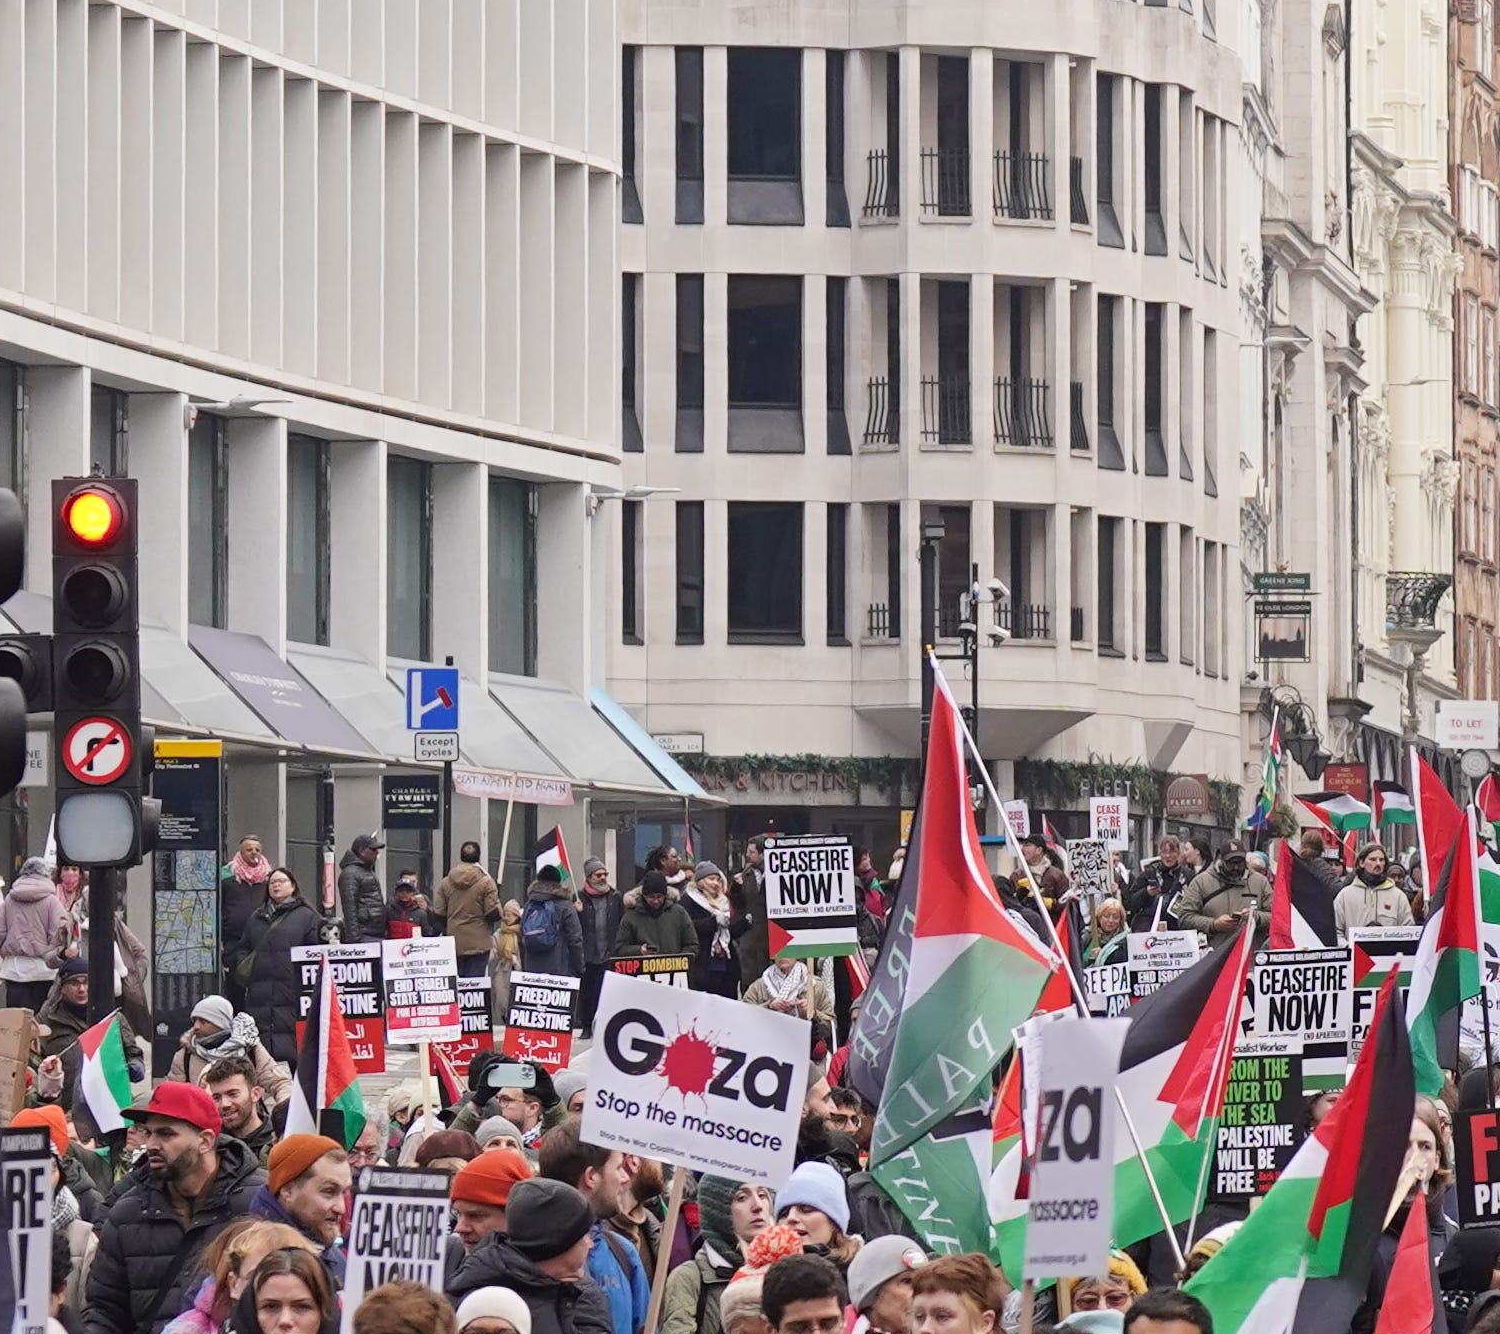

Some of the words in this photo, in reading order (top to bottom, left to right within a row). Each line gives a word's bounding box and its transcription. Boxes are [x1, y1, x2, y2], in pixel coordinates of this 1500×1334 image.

[1451, 720, 1462, 728] TO
[1466, 720, 1482, 728] LET
[420, 737, 454, 748] Except
[421, 748, 452, 757] cycles
[758, 773, 848, 791] KITCHEN
[1097, 805, 1120, 814] CEASE
[1097, 817, 1121, 827] FRE
[1097, 829, 1121, 840] NOW!
[768, 849, 850, 874] CEASEFIRE
[779, 874, 845, 908] NOW!
[302, 962, 372, 984] FEDOM
[615, 961, 640, 973] STOP
[642, 958, 689, 972] BOMBING
[1137, 971, 1156, 983] END
[1259, 965, 1347, 995] CEASEFIRE
[301, 993, 378, 1017] PSTINE
[389, 992, 418, 1006] STATE
[515, 986, 572, 1007] FREEDOM
[509, 1009, 571, 1030] PALESTINE
[1268, 994, 1338, 1032] NOW!
[604, 1008, 794, 1112] Gza
[1264, 1057, 1290, 1078] THE
[1264, 1080, 1282, 1101] TO
[596, 1089, 641, 1120] Stop
[647, 1103, 677, 1127] the
[682, 1114, 783, 1152] massacre
[1220, 1105, 1246, 1126] THE
[1250, 1103, 1276, 1124] SEA
[1218, 1125, 1293, 1148] PALESTINE
[1217, 1148, 1254, 1170] WILL
[1257, 1148, 1275, 1169] BE
[1217, 1172, 1254, 1193] FREE
[355, 1202, 445, 1261] CEASEFIRE
